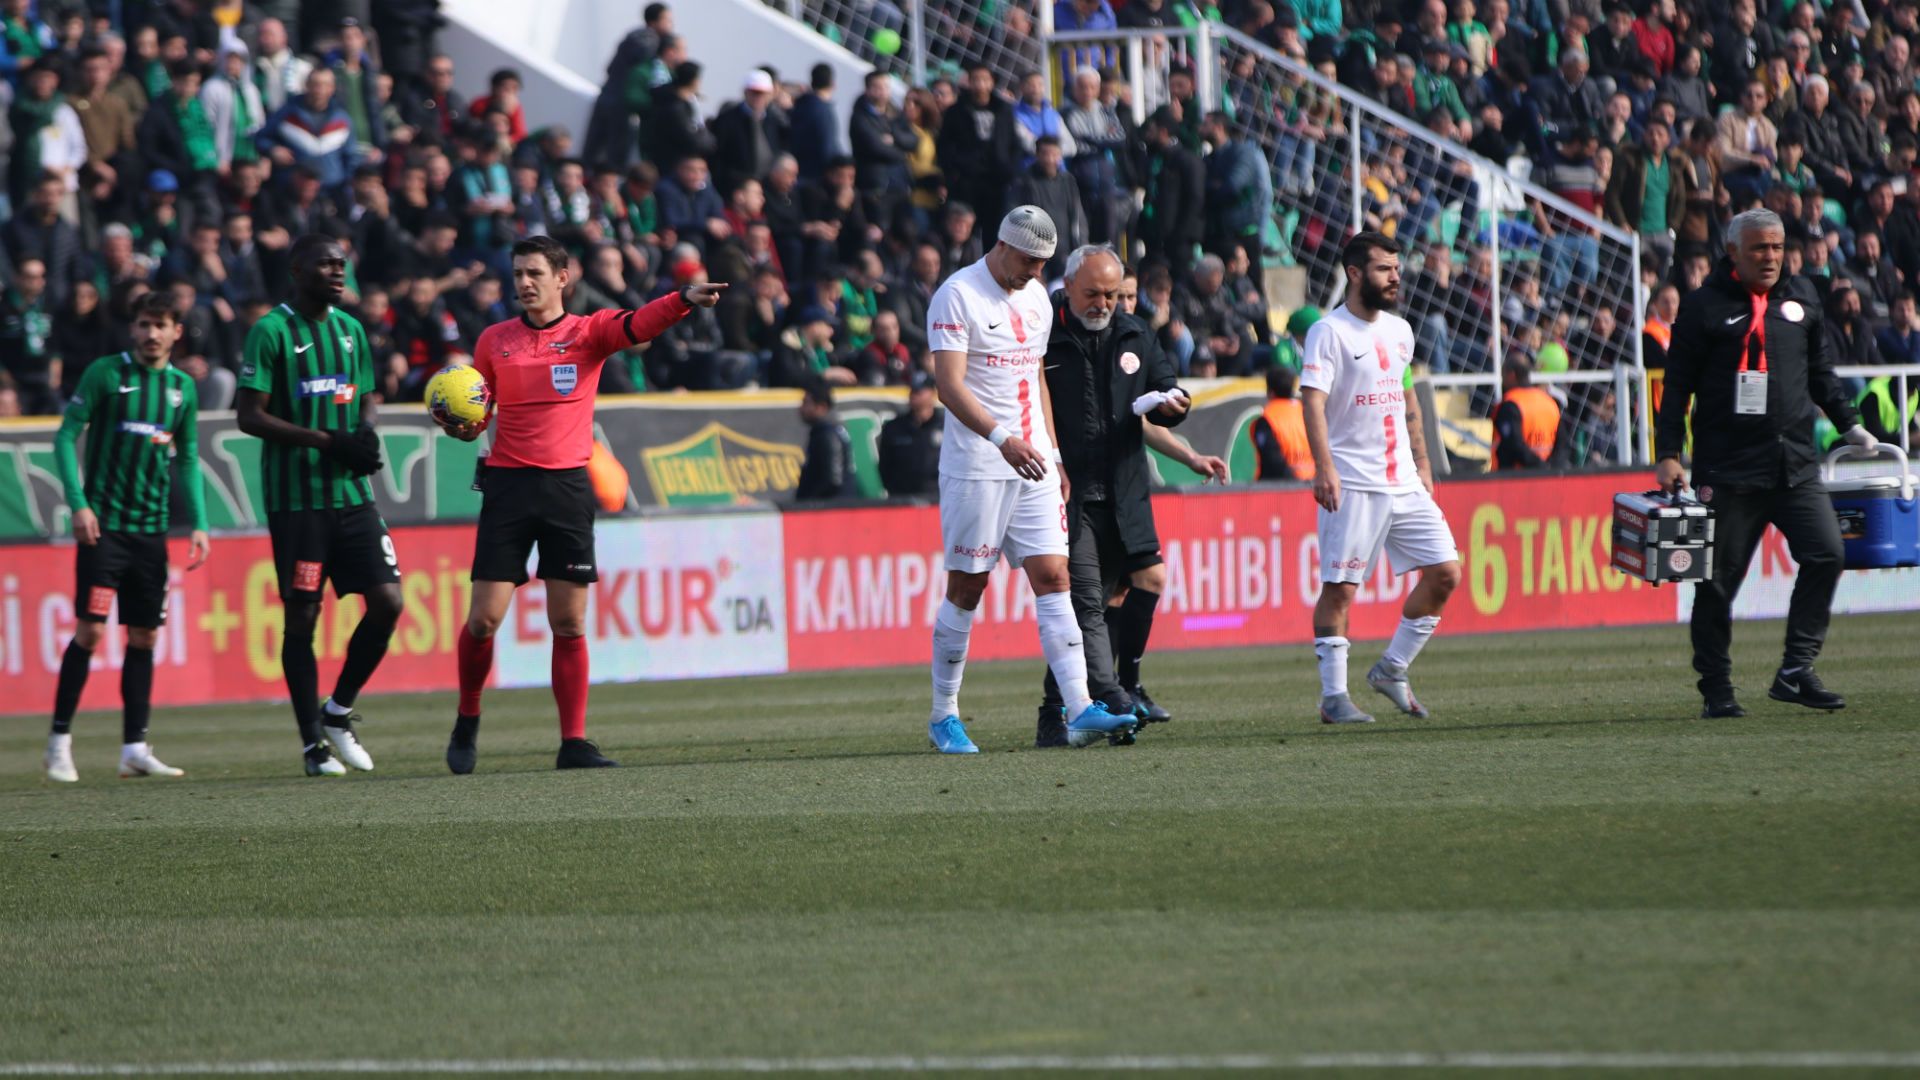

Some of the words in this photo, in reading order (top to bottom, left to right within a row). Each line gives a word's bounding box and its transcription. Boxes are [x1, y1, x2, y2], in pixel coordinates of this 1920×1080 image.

[554, 366, 575, 375] FIFA
[986, 354, 1040, 367] REGNU
[1355, 391, 1405, 406] REGNU
[381, 534, 398, 567] 9
[1159, 515, 1283, 614] AHİBİ
[1514, 515, 1643, 597] TAKS
[514, 567, 724, 645] EKUR
[793, 551, 1038, 634] KAMPAYA
